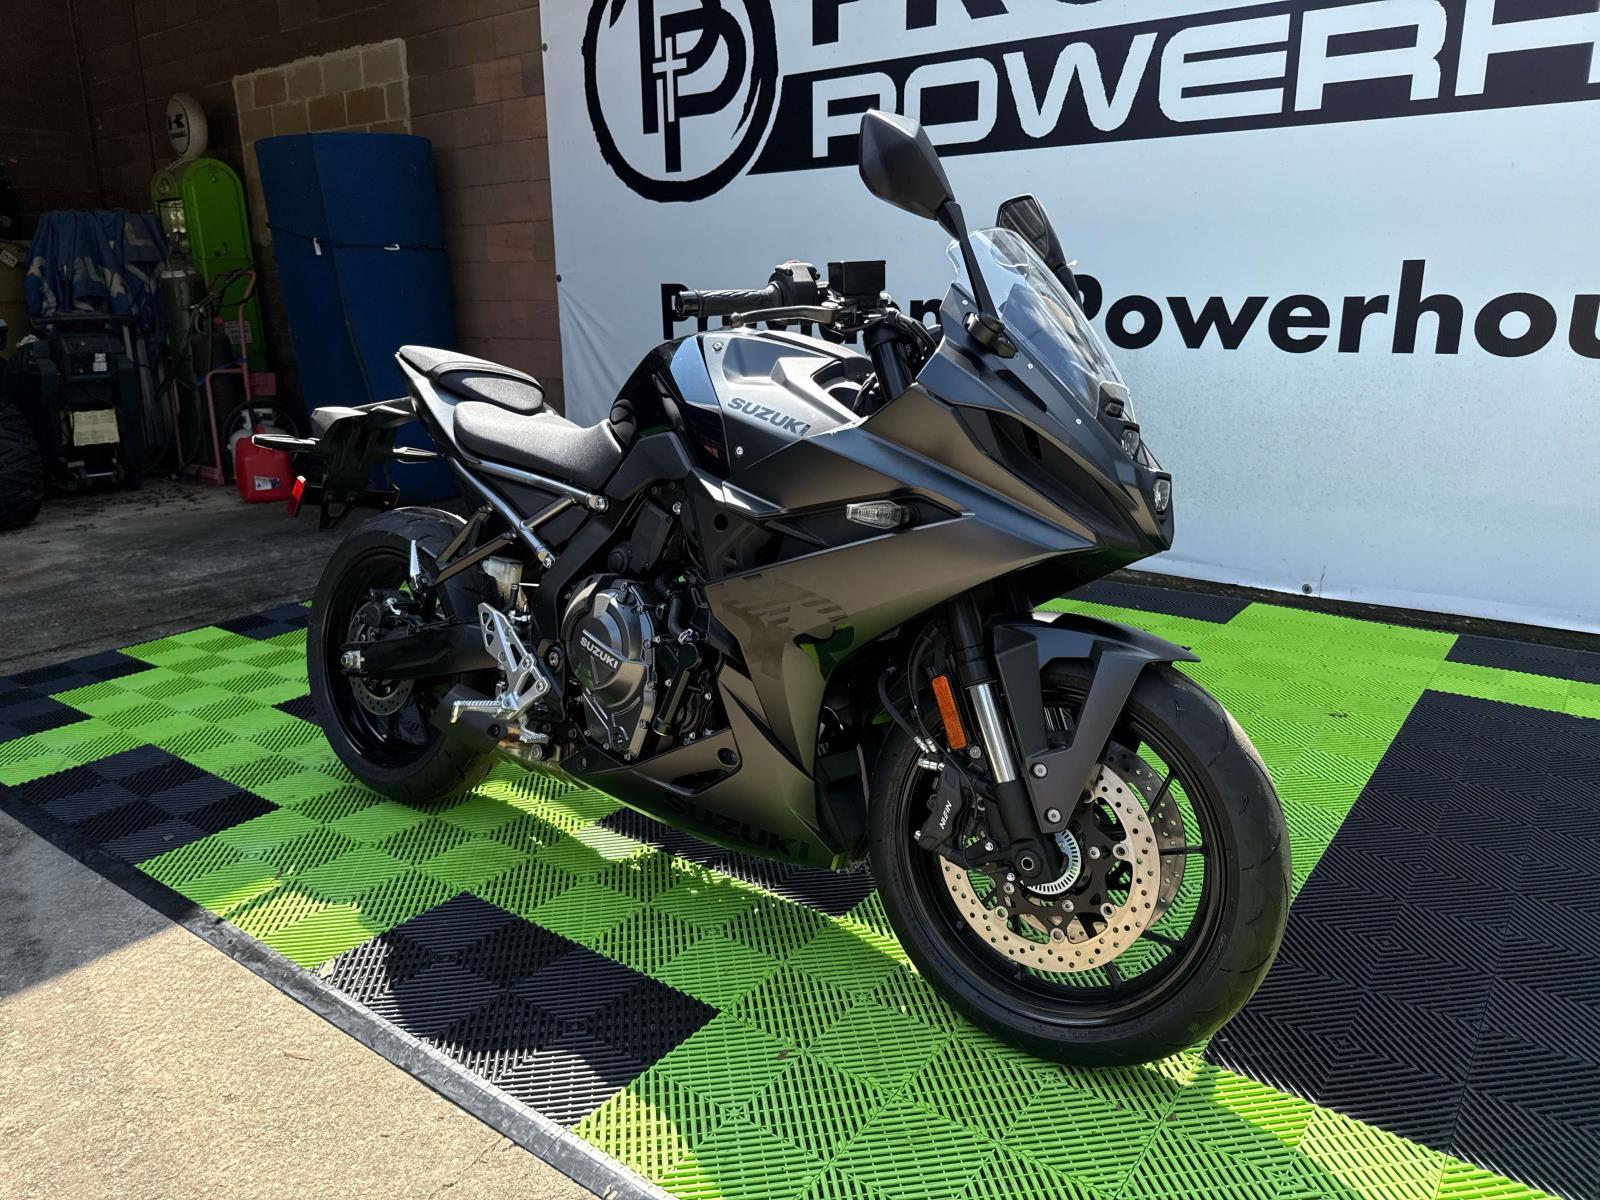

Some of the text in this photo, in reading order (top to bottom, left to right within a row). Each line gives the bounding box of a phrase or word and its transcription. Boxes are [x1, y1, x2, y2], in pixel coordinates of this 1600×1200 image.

[728, 397, 812, 437] SUZUKI
[580, 636, 619, 669] SUZUKI
[664, 792, 810, 860] SUZUKI
